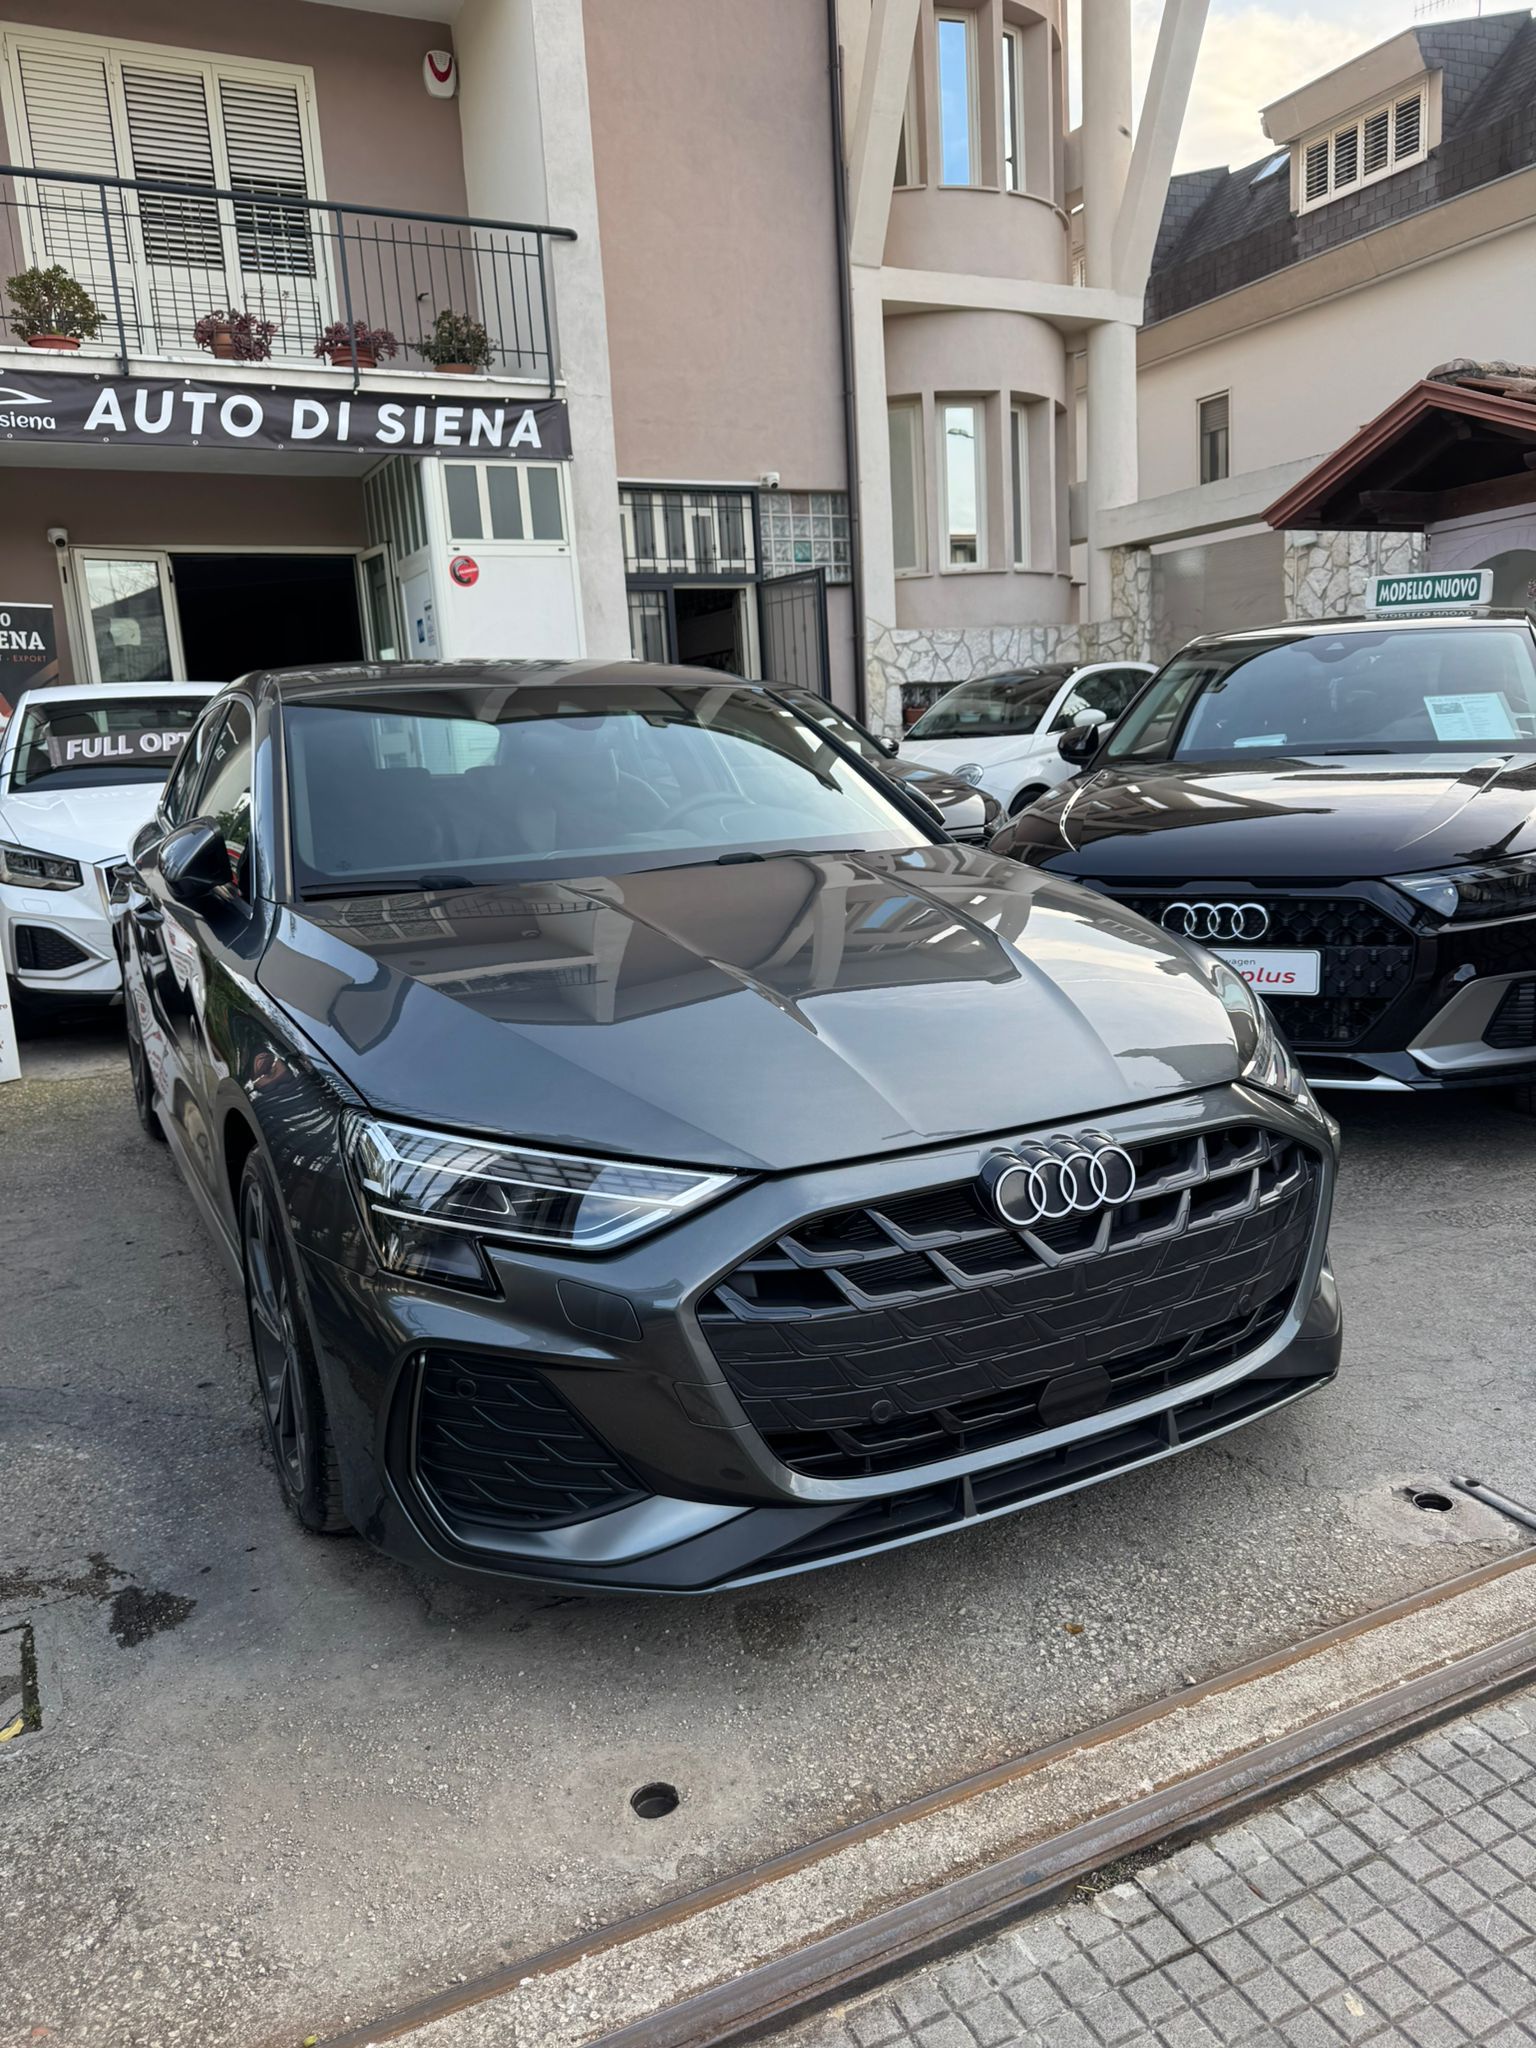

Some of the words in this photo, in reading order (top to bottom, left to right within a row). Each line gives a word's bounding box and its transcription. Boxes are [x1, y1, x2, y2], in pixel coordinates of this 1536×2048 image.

[0, 411, 56, 430] siena
[83, 388, 264, 438] AUTO
[291, 399, 350, 441] DI
[376, 403, 542, 448] SIENA
[1378, 580, 1433, 602] MODELLO
[1434, 577, 1478, 599] NUOVO
[13, 654, 47, 662] EXPORT
[66, 735, 134, 760] FULL
[1240, 967, 1297, 984] plus
